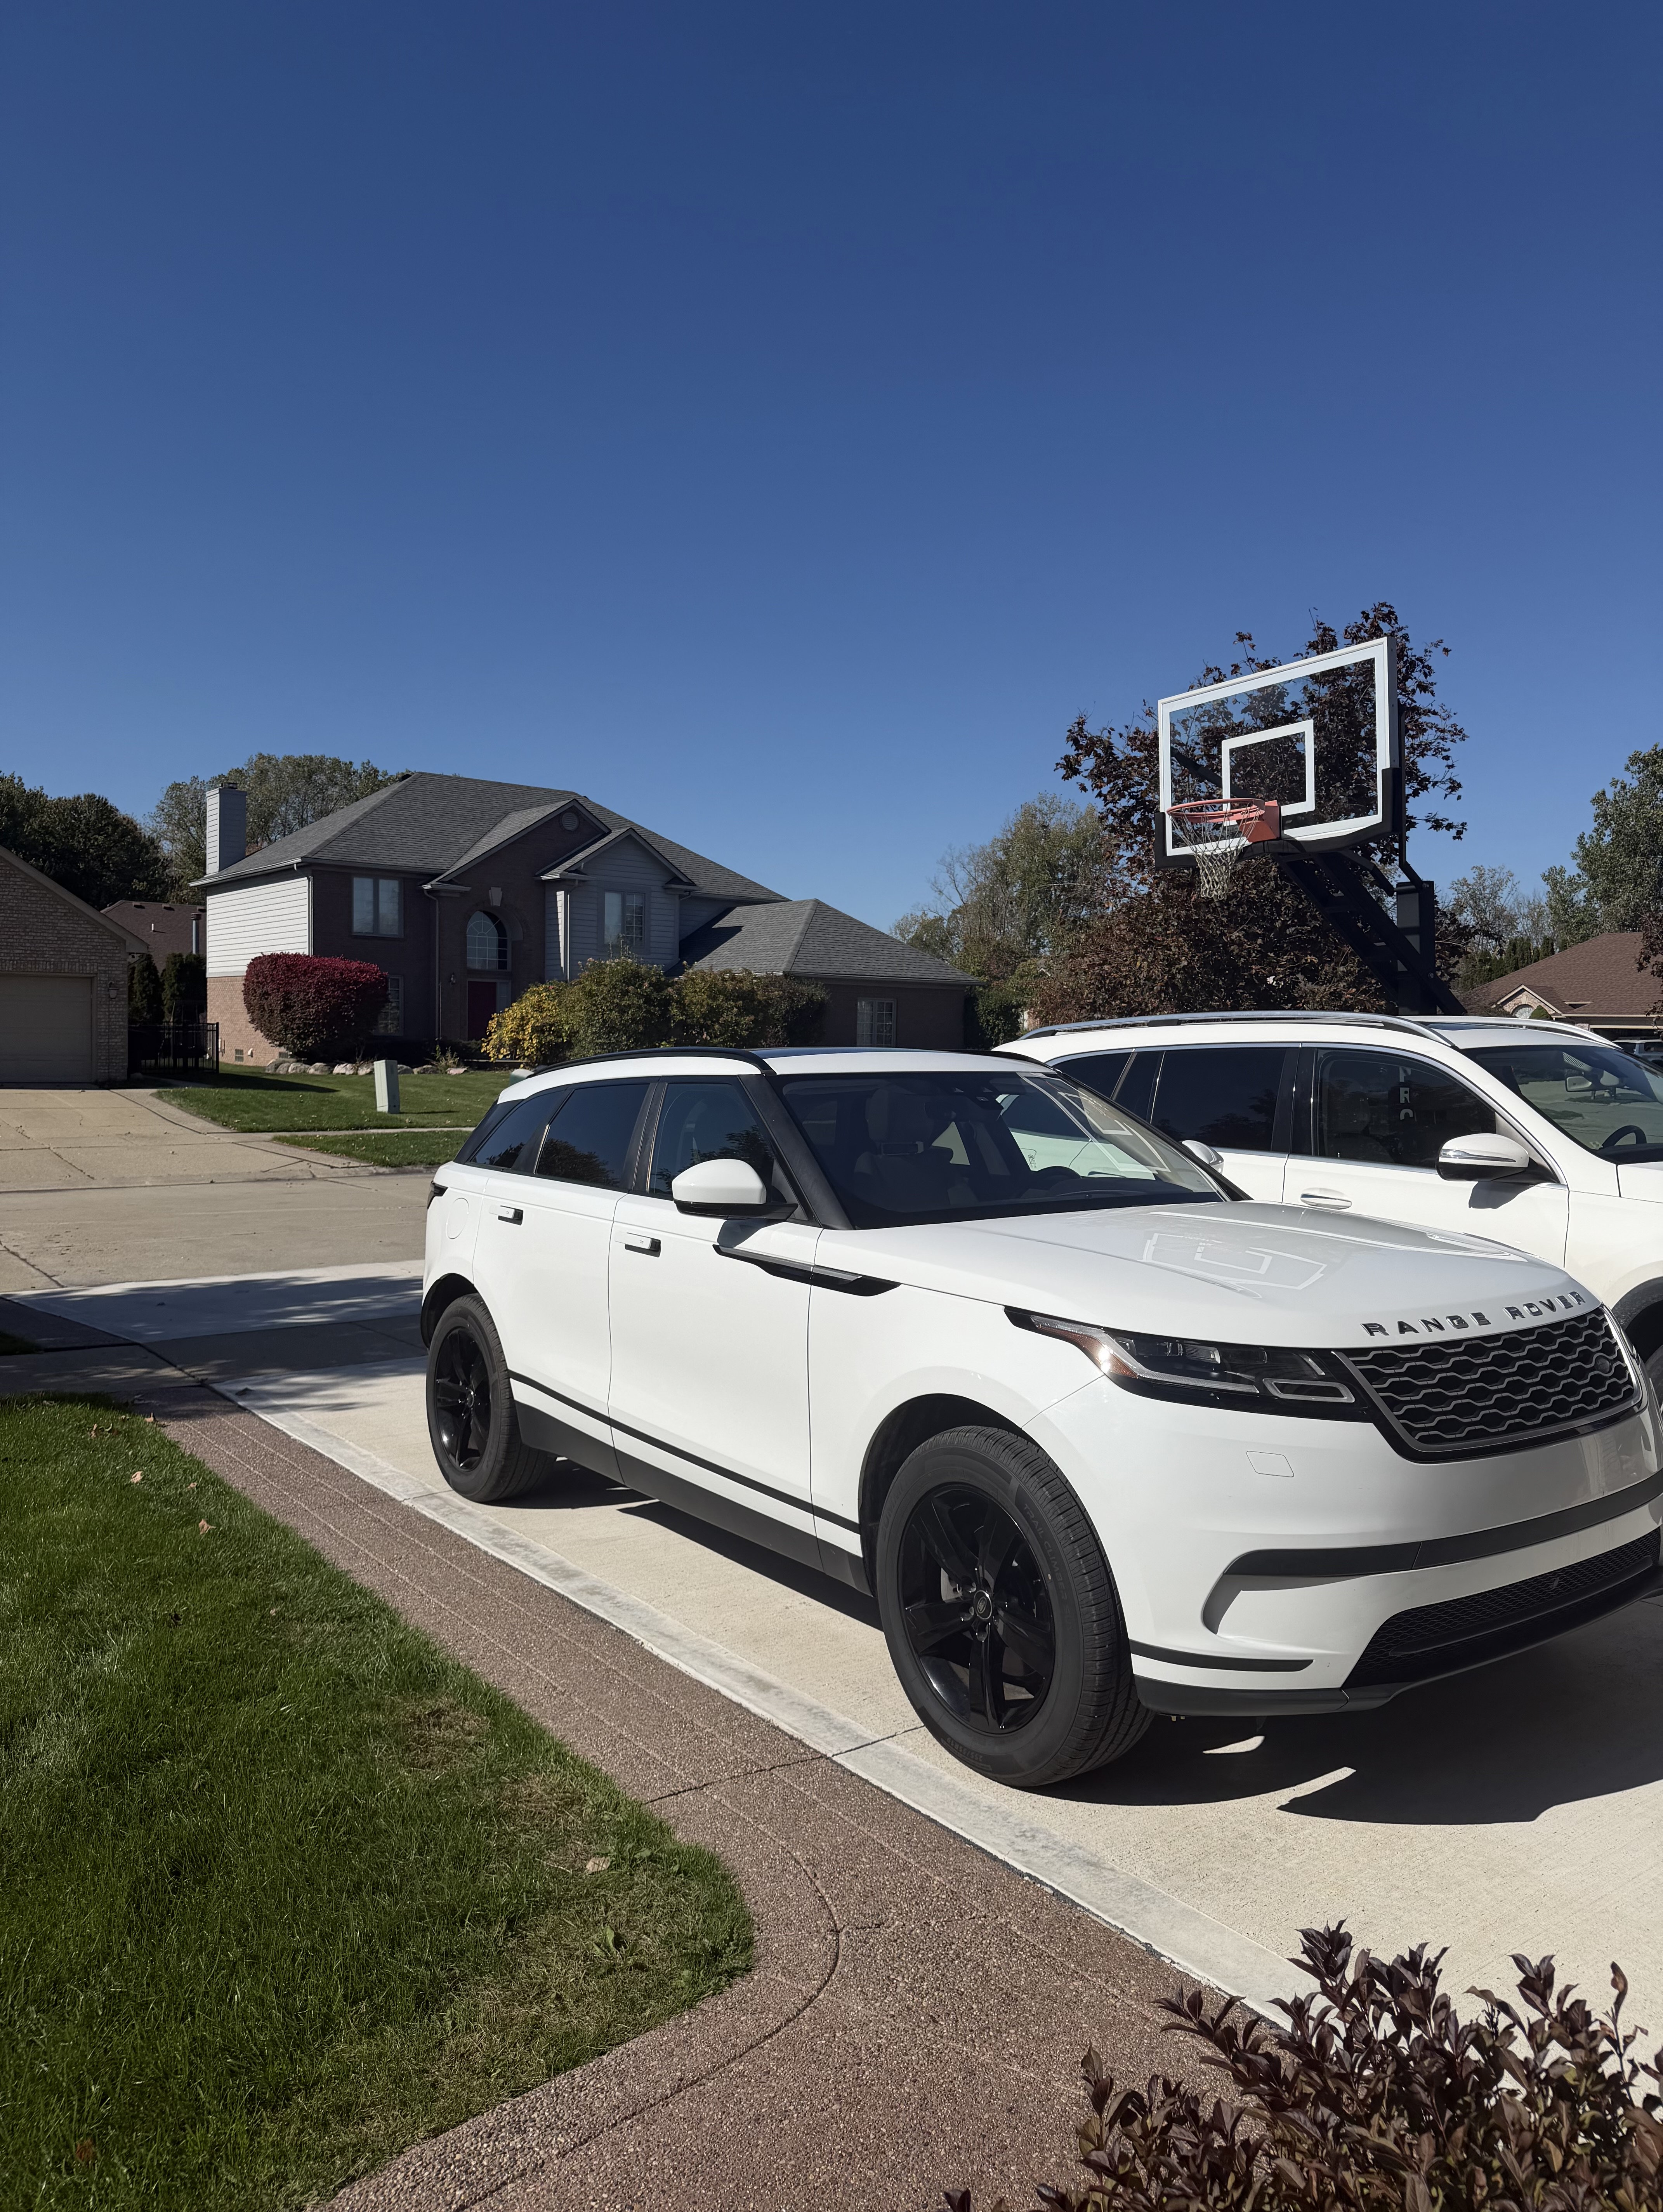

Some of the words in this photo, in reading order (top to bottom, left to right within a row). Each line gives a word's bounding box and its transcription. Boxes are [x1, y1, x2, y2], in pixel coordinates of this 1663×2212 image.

[1360, 1312, 1491, 1337] RANGE
[1502, 1291, 1586, 1320] ROVER
[1024, 1503, 1044, 1539] TRAIL
[1044, 1540, 1068, 1600] CLIMBER
